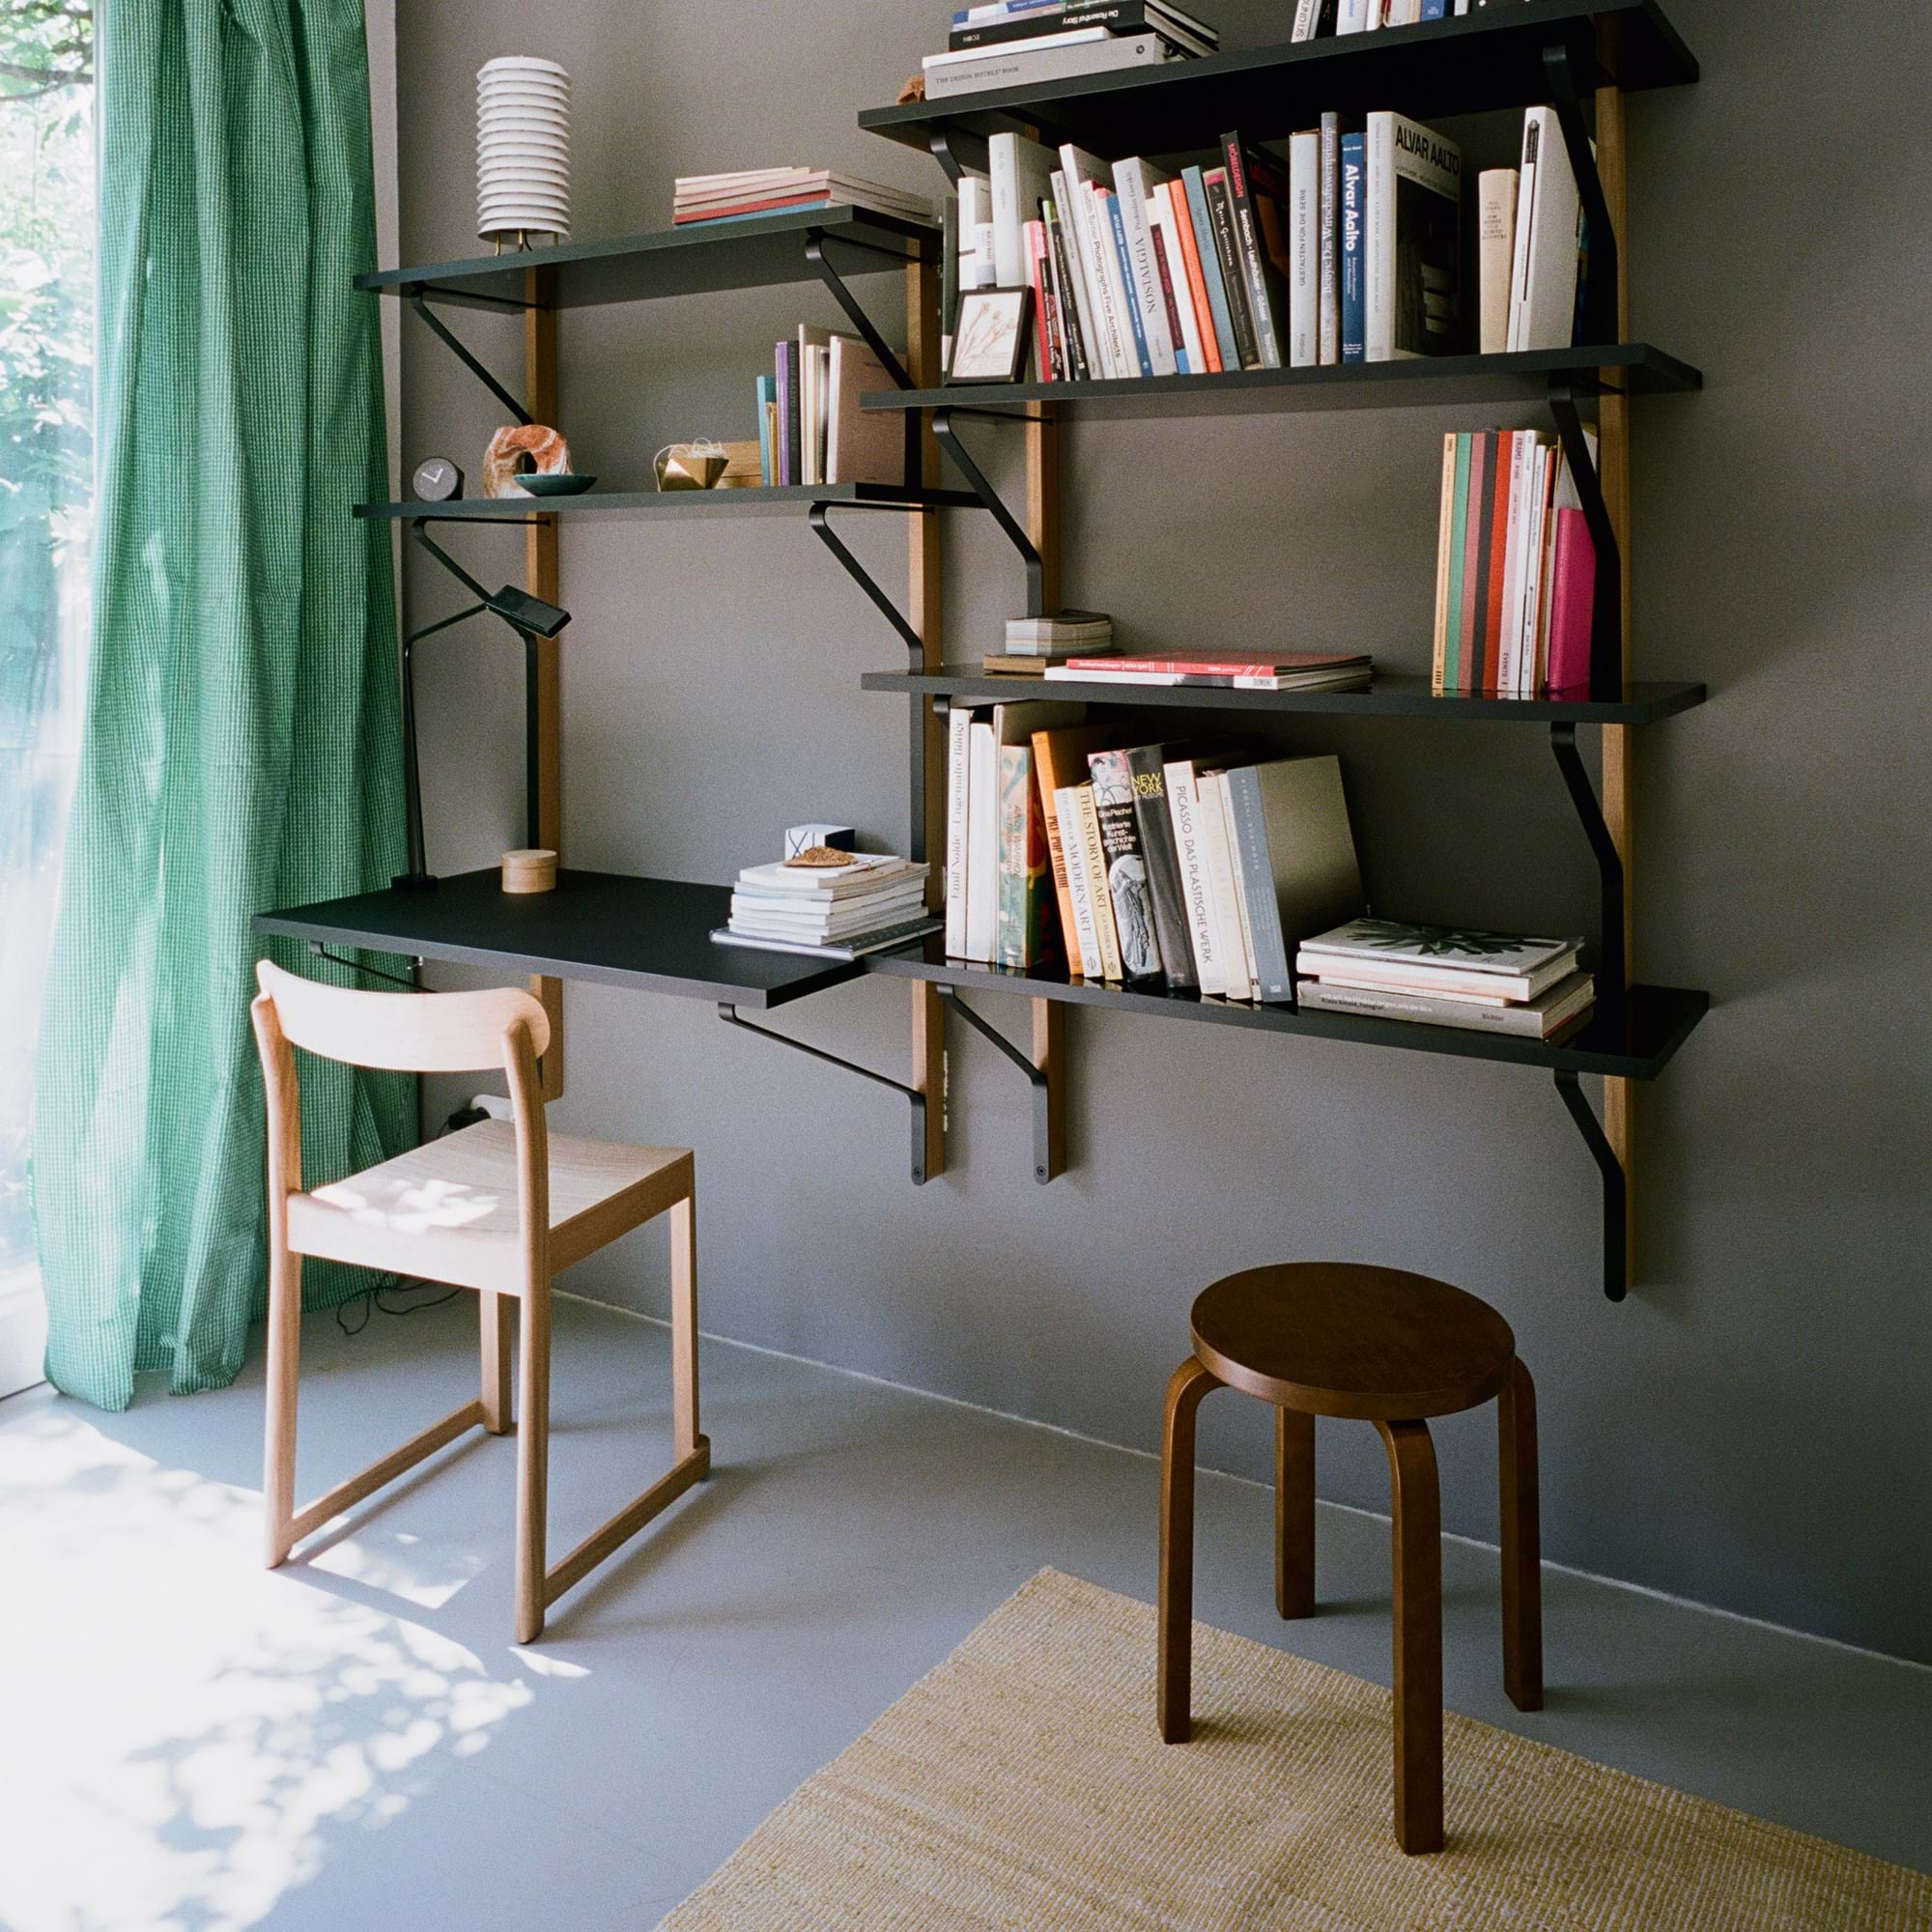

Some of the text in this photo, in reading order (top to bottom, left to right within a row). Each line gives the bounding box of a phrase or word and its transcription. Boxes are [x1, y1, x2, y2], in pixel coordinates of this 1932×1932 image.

[1396, 125, 1460, 176] ALVAR AALTO
[1345, 164, 1359, 250] Alvar Aalto
[1239, 209, 1253, 245] Sembach
[1322, 241, 1332, 259] Das
[1094, 242, 1110, 295] Photographs
[1135, 237, 1157, 313] NOSTALGIA
[1105, 297, 1114, 314] Five
[1108, 315, 1122, 357] Architects
[954, 721, 965, 755] Bilder
[1131, 773, 1160, 786] NEW
[1132, 782, 1163, 795] YORK
[1079, 792, 1093, 820] THE
[952, 834, 961, 867] Nolde
[1047, 815, 1070, 889] PRE POP WARHOL
[1083, 820, 1100, 861] STORY
[951, 871, 959, 897] Emil
[1068, 842, 1088, 904] MODERN
[1078, 907, 1093, 935] ART
[1090, 864, 1101, 883] OF
[1177, 785, 1212, 963] PICASSO DAS PLASTISCHE WERK
[1094, 886, 1107, 910] ART
